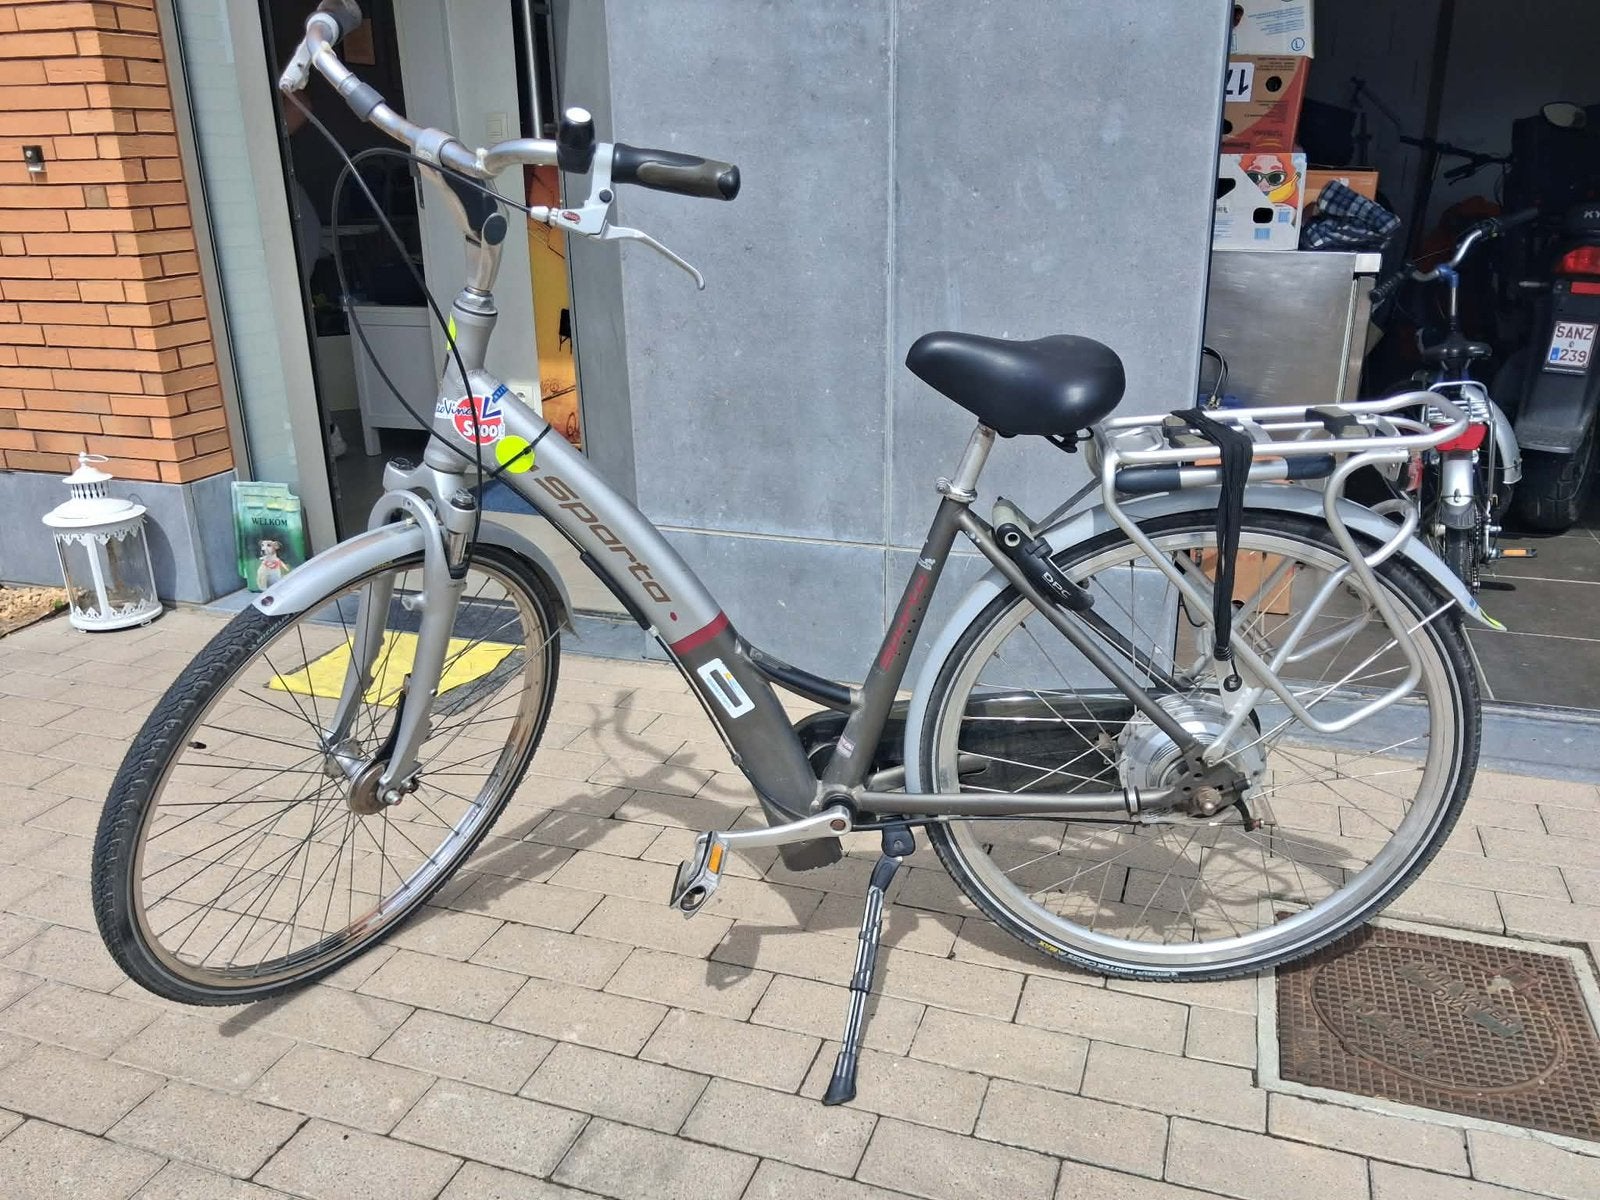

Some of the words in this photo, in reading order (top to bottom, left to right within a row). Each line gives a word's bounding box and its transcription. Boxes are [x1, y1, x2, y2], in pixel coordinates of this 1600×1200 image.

[1555, 325, 1595, 341] SANZ
[1559, 348, 1587, 363] 239
[251, 517, 288, 527] WELKOM
[1456, 989, 1517, 1027] WATER
